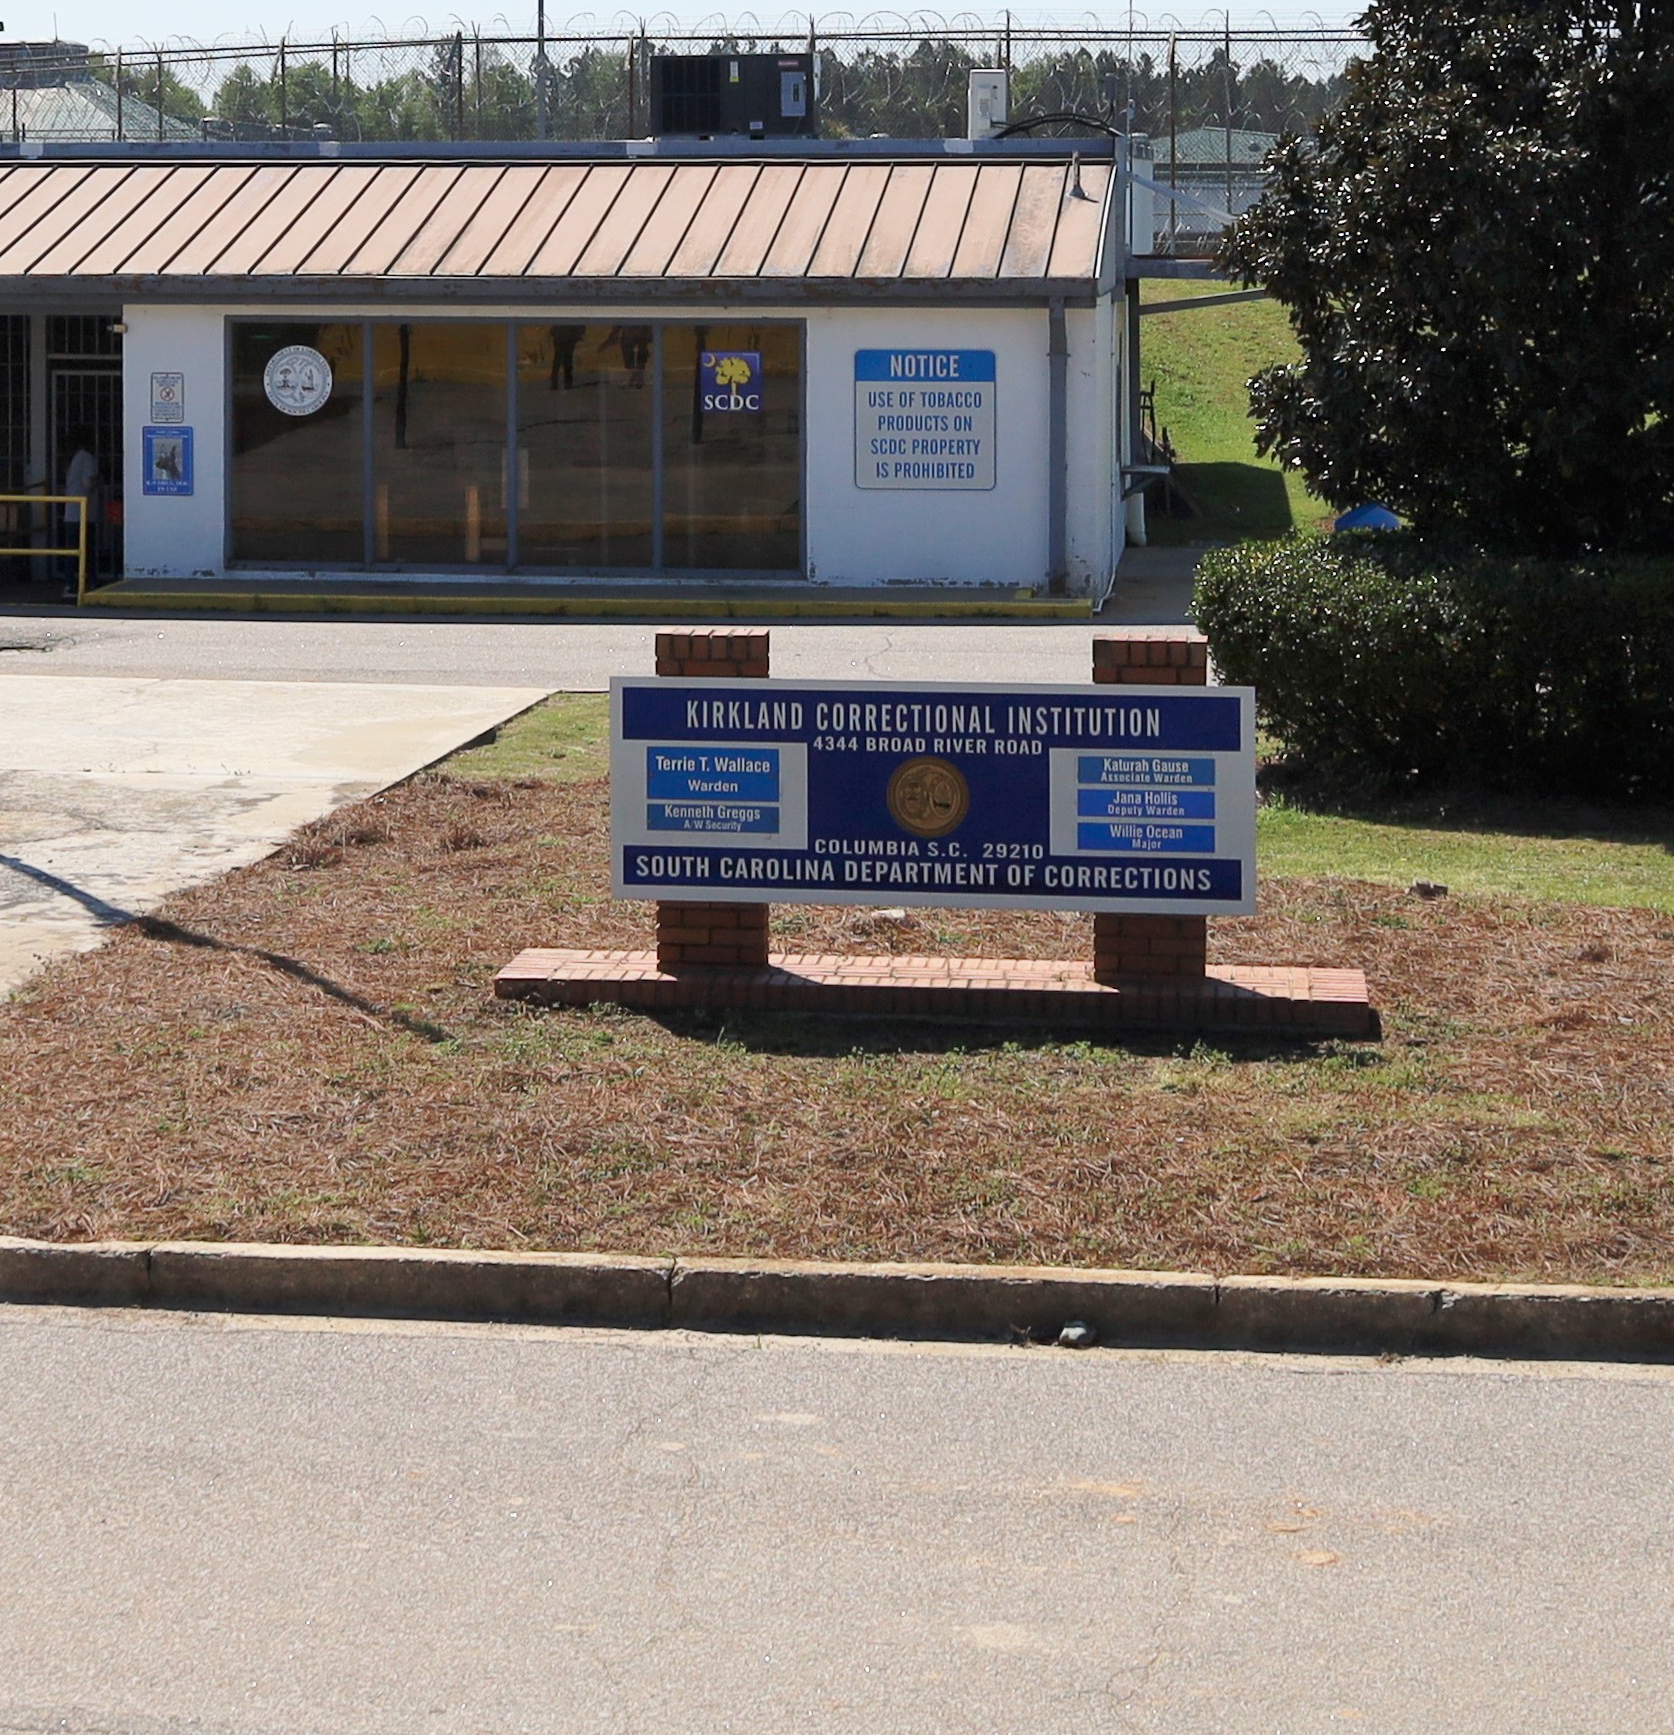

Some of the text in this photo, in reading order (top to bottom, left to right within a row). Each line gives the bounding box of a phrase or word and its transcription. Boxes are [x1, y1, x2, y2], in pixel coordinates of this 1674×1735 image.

[890, 355, 960, 377] NOTICE
[704, 394, 759, 411] SCDC
[868, 392, 982, 408] USE OF TOBACCO
[878, 415, 972, 432] PRODUCTS ON
[870, 439, 980, 455] SCDC PROPERTY
[876, 462, 975, 479] IS PROHIBITED
[687, 700, 1160, 737] KIRKLAND CORRECTIONAL INSTITUTION
[813, 736, 1043, 755] 4344 BROAD RIVER ROAD
[656, 755, 770, 773] Terrie T. Wallace
[1103, 758, 1189, 773] Katurah Gause
[688, 779, 738, 792] Warden
[1100, 772, 1193, 784] Associate Warden
[1113, 791, 1178, 805] Jana Hollis
[664, 804, 761, 822] Kenneth Greggs
[1108, 805, 1185, 816] Deputy Warden
[684, 820, 742, 832] A/W Security
[1110, 824, 1183, 839] Willie Ocean
[814, 839, 1044, 859] COLUMBIA S.C. 29210
[1132, 839, 1162, 850] Major
[636, 856, 1211, 890] SOUTH CAROLINA DEPARTMENT OF CORRECTIONS
